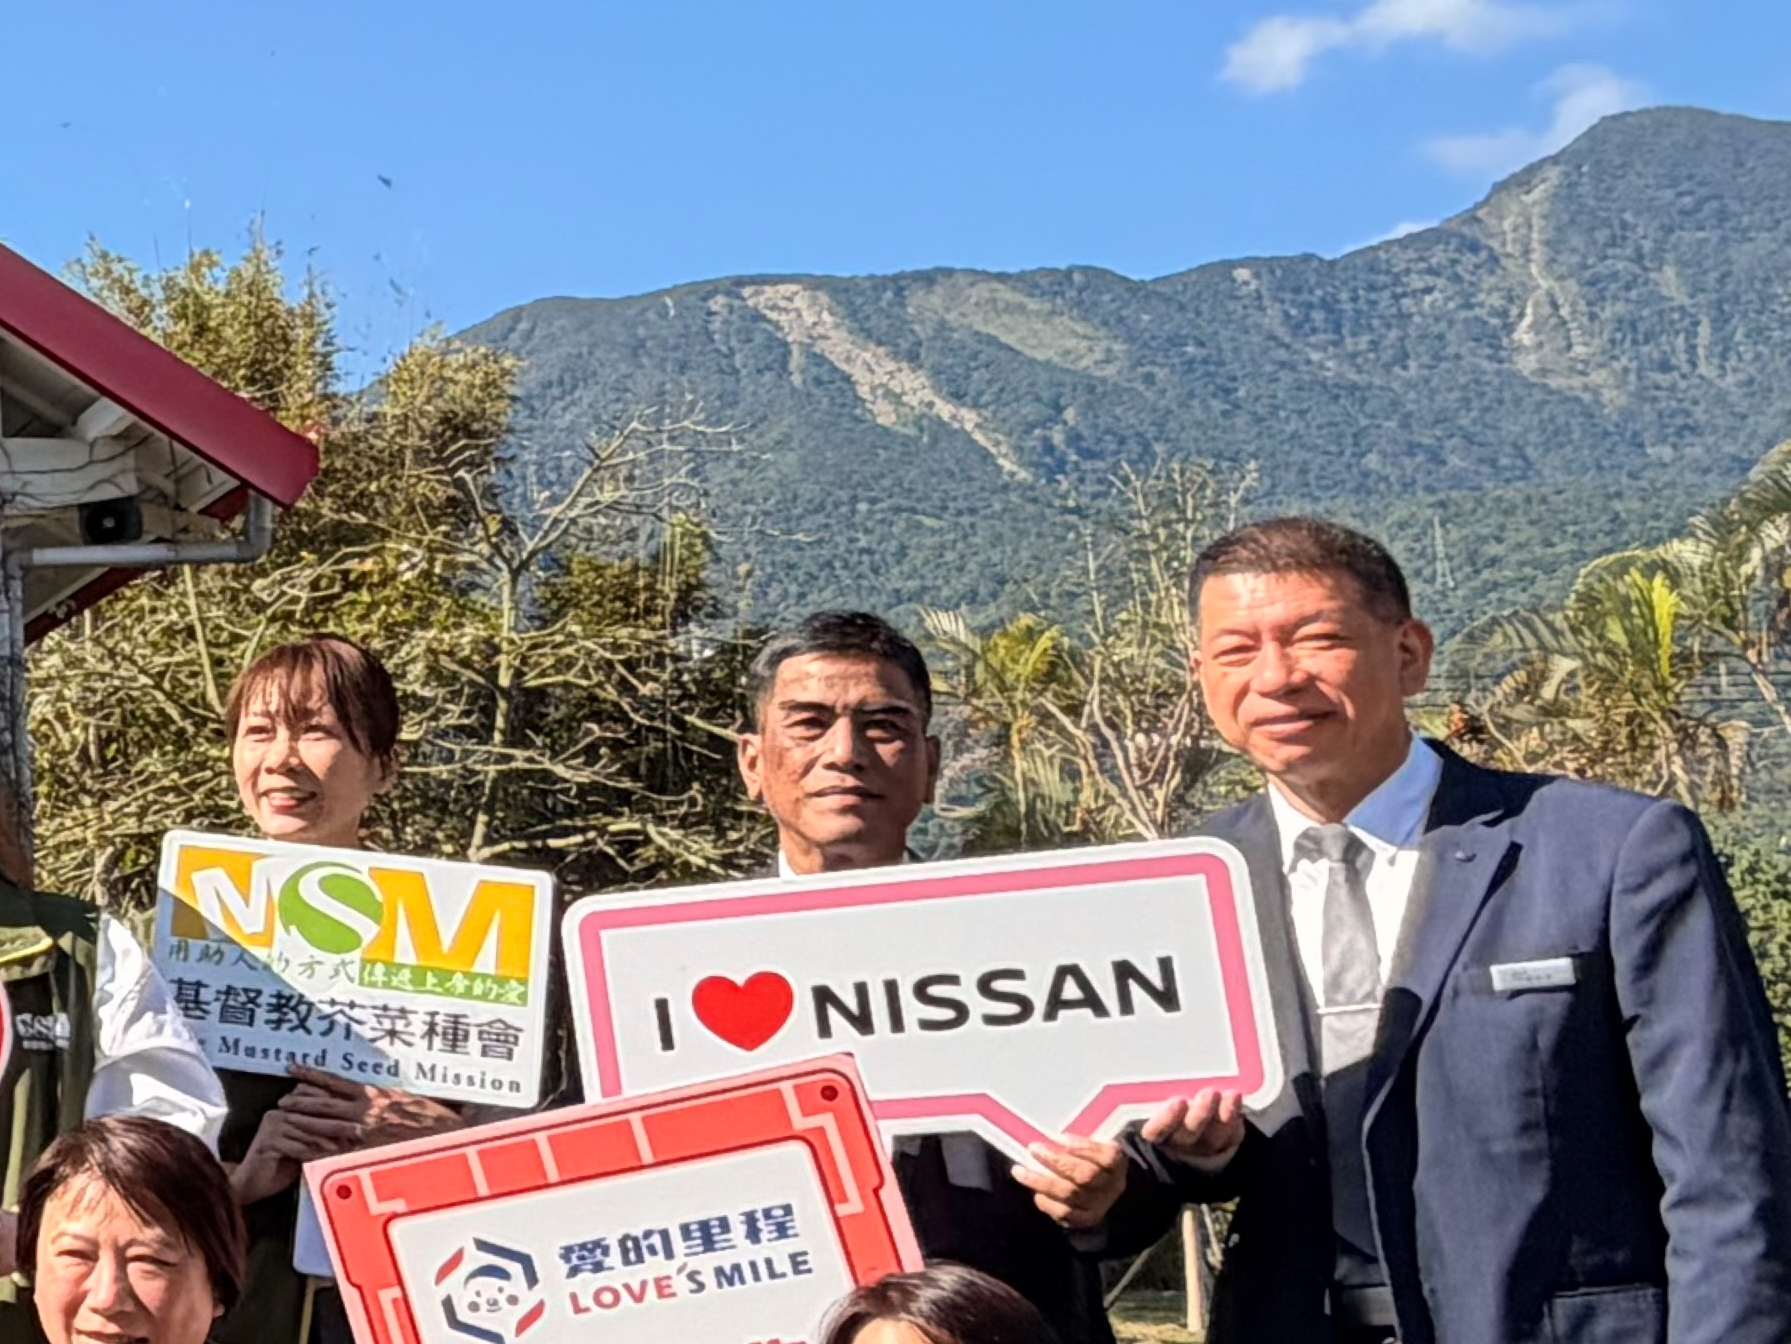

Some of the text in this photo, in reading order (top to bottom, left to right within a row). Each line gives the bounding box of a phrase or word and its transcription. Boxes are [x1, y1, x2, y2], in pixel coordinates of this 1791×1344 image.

[169, 977, 523, 1062] 基督教芥菜種會
[655, 955, 1182, 1052] I NISSAN
[219, 1036, 328, 1067] Mustard
[341, 1052, 400, 1078] Seed
[414, 1062, 522, 1094] Mission
[558, 1202, 800, 1280] 愛的里程
[713, 1251, 814, 1301] MILE
